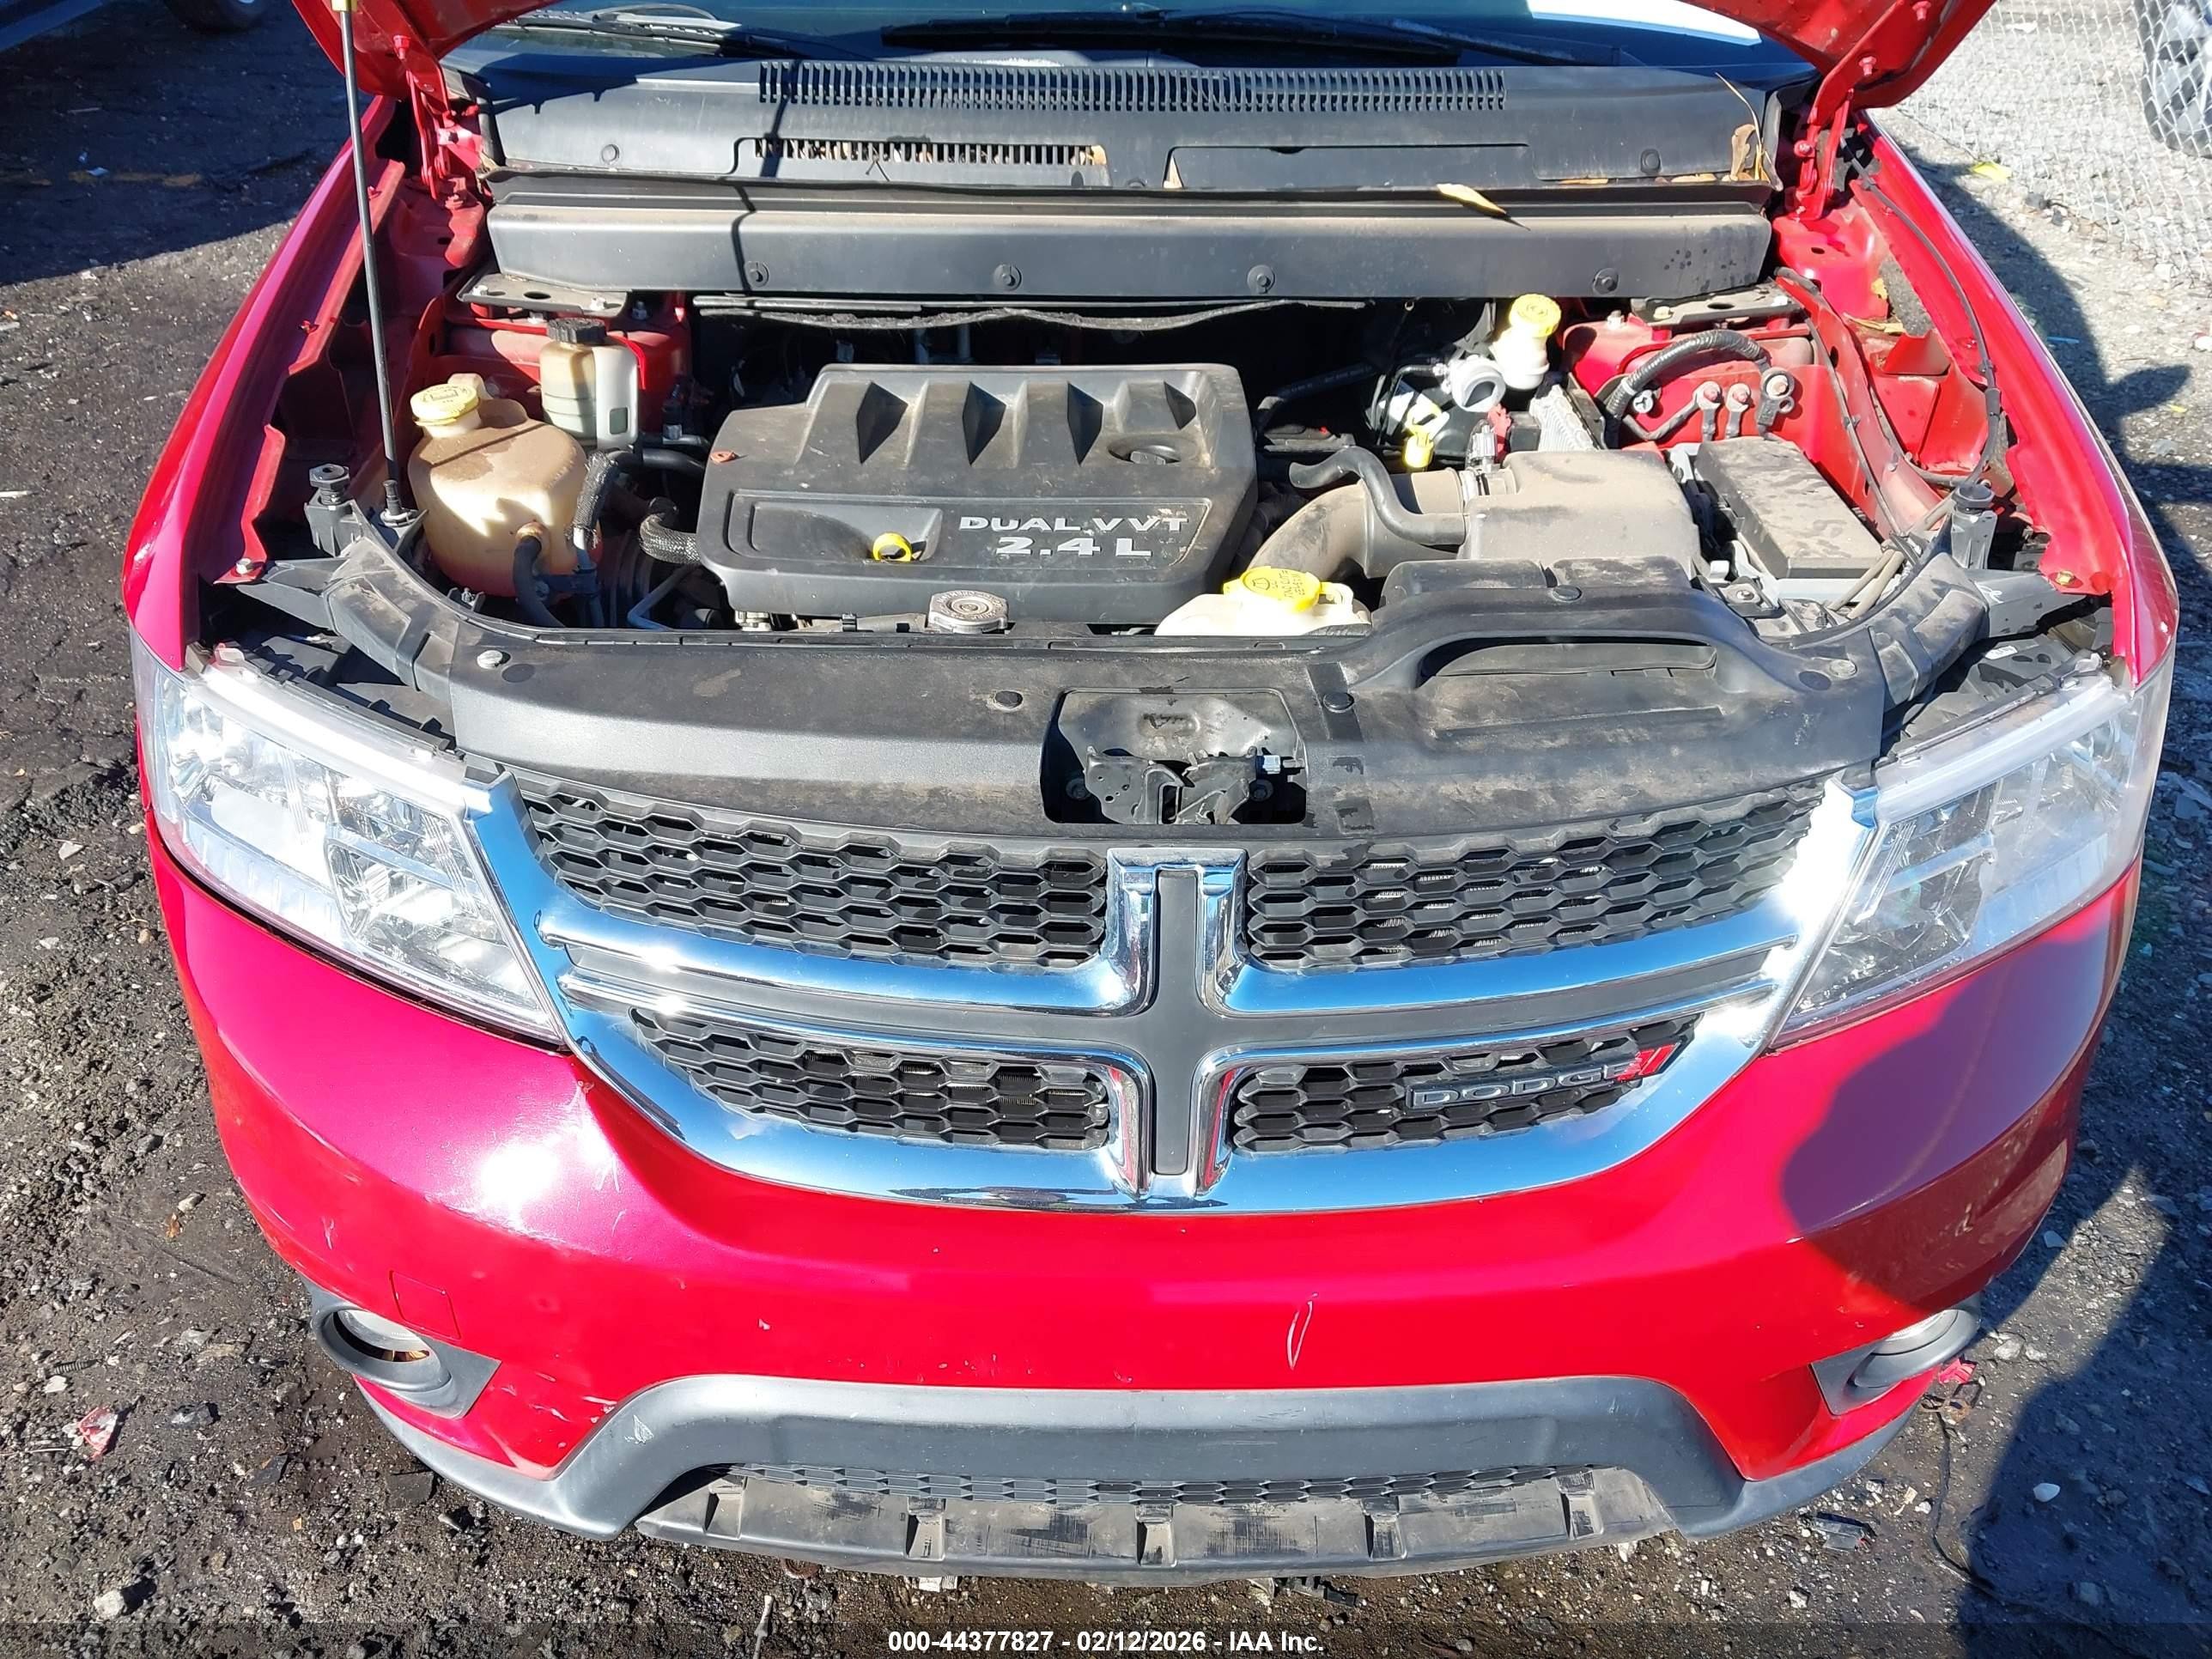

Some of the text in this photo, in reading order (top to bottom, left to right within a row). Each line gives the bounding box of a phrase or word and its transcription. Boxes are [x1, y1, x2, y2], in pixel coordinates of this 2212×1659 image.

[959, 517, 1188, 532] DUAL VVT
[1409, 1060, 1637, 1109] DODGE
